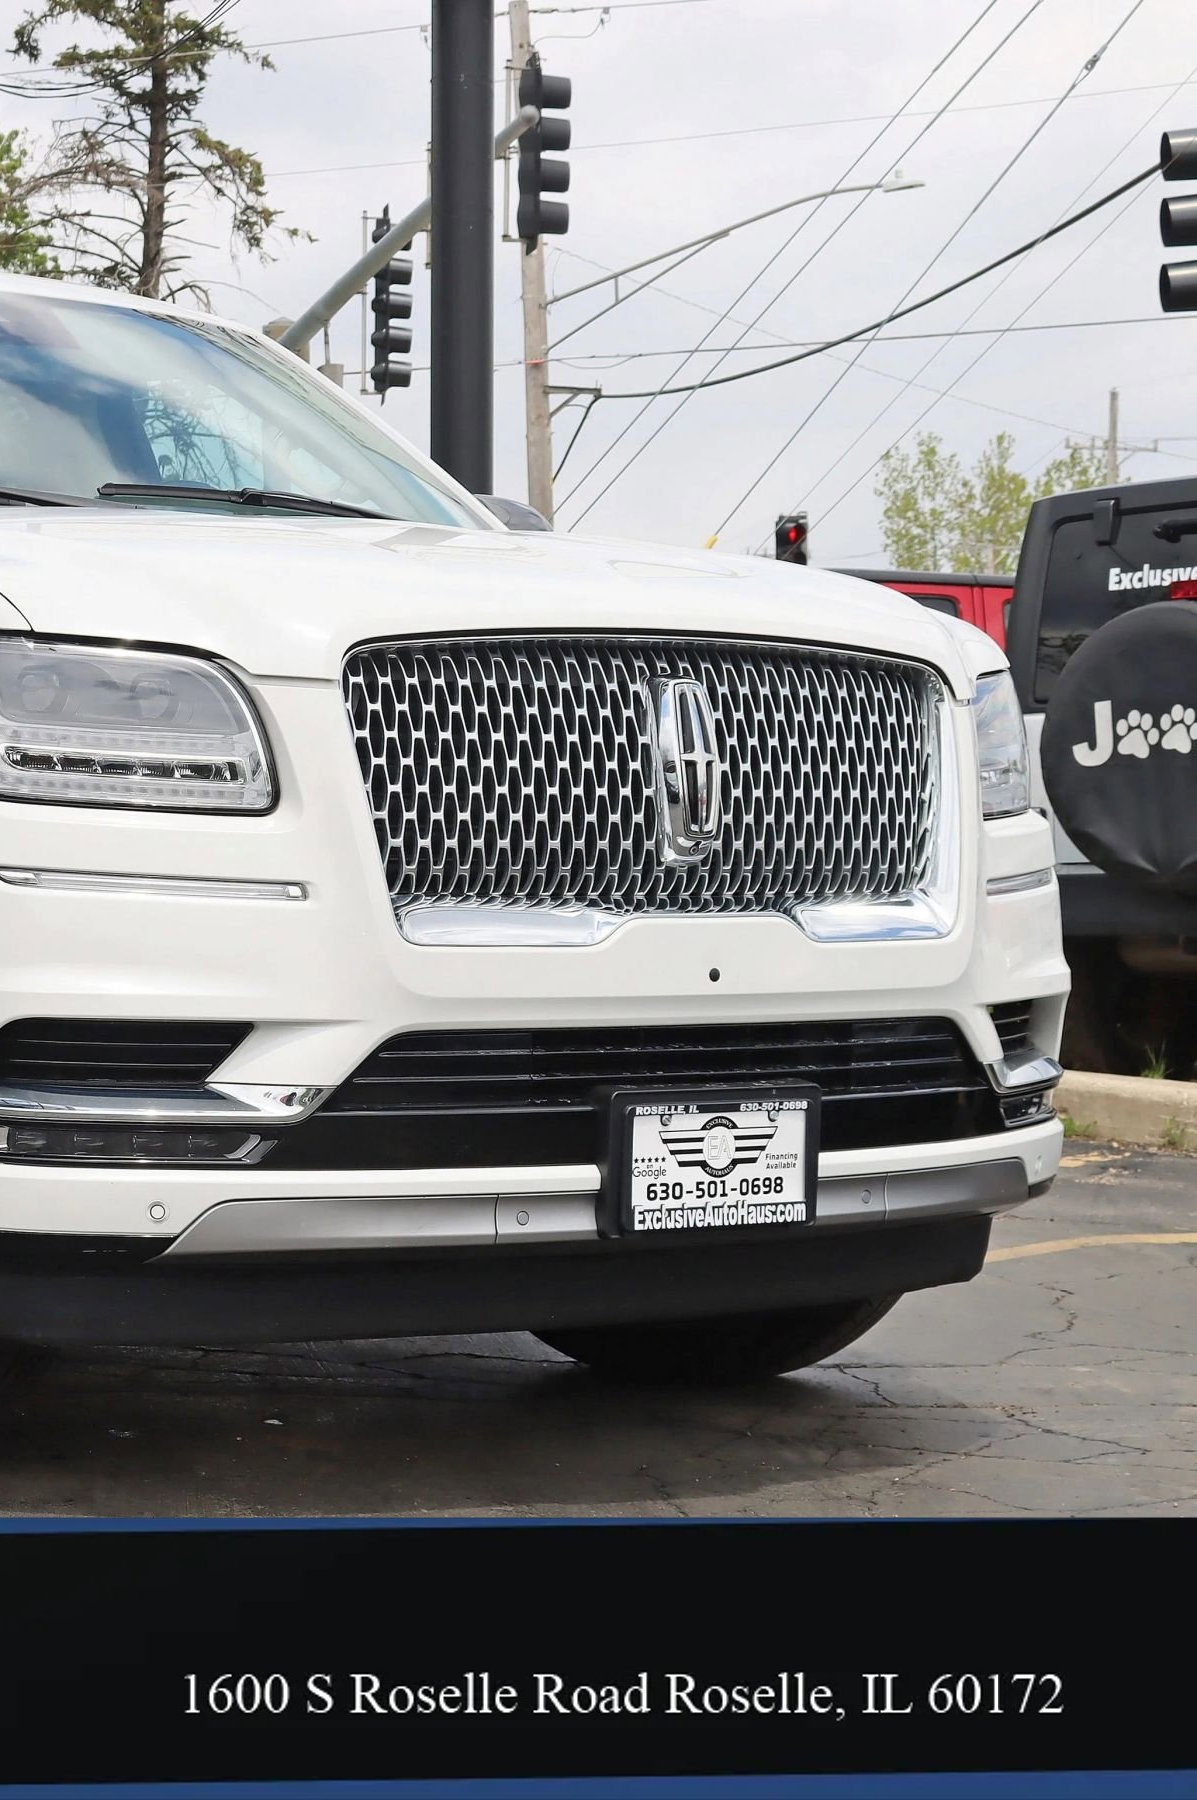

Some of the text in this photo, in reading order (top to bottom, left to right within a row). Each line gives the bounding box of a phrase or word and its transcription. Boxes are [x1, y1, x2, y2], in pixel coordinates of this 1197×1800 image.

[635, 1105, 700, 1115] ROSELLE, IL
[740, 1101, 808, 1112] 630-501-0698
[765, 1152, 798, 1162] Financing
[766, 1161, 797, 1170] Available
[632, 1166, 667, 1179] Google
[646, 1176, 784, 1201] 630-501-0698
[634, 1200, 807, 1230] ExclusiveAutoHaus.com
